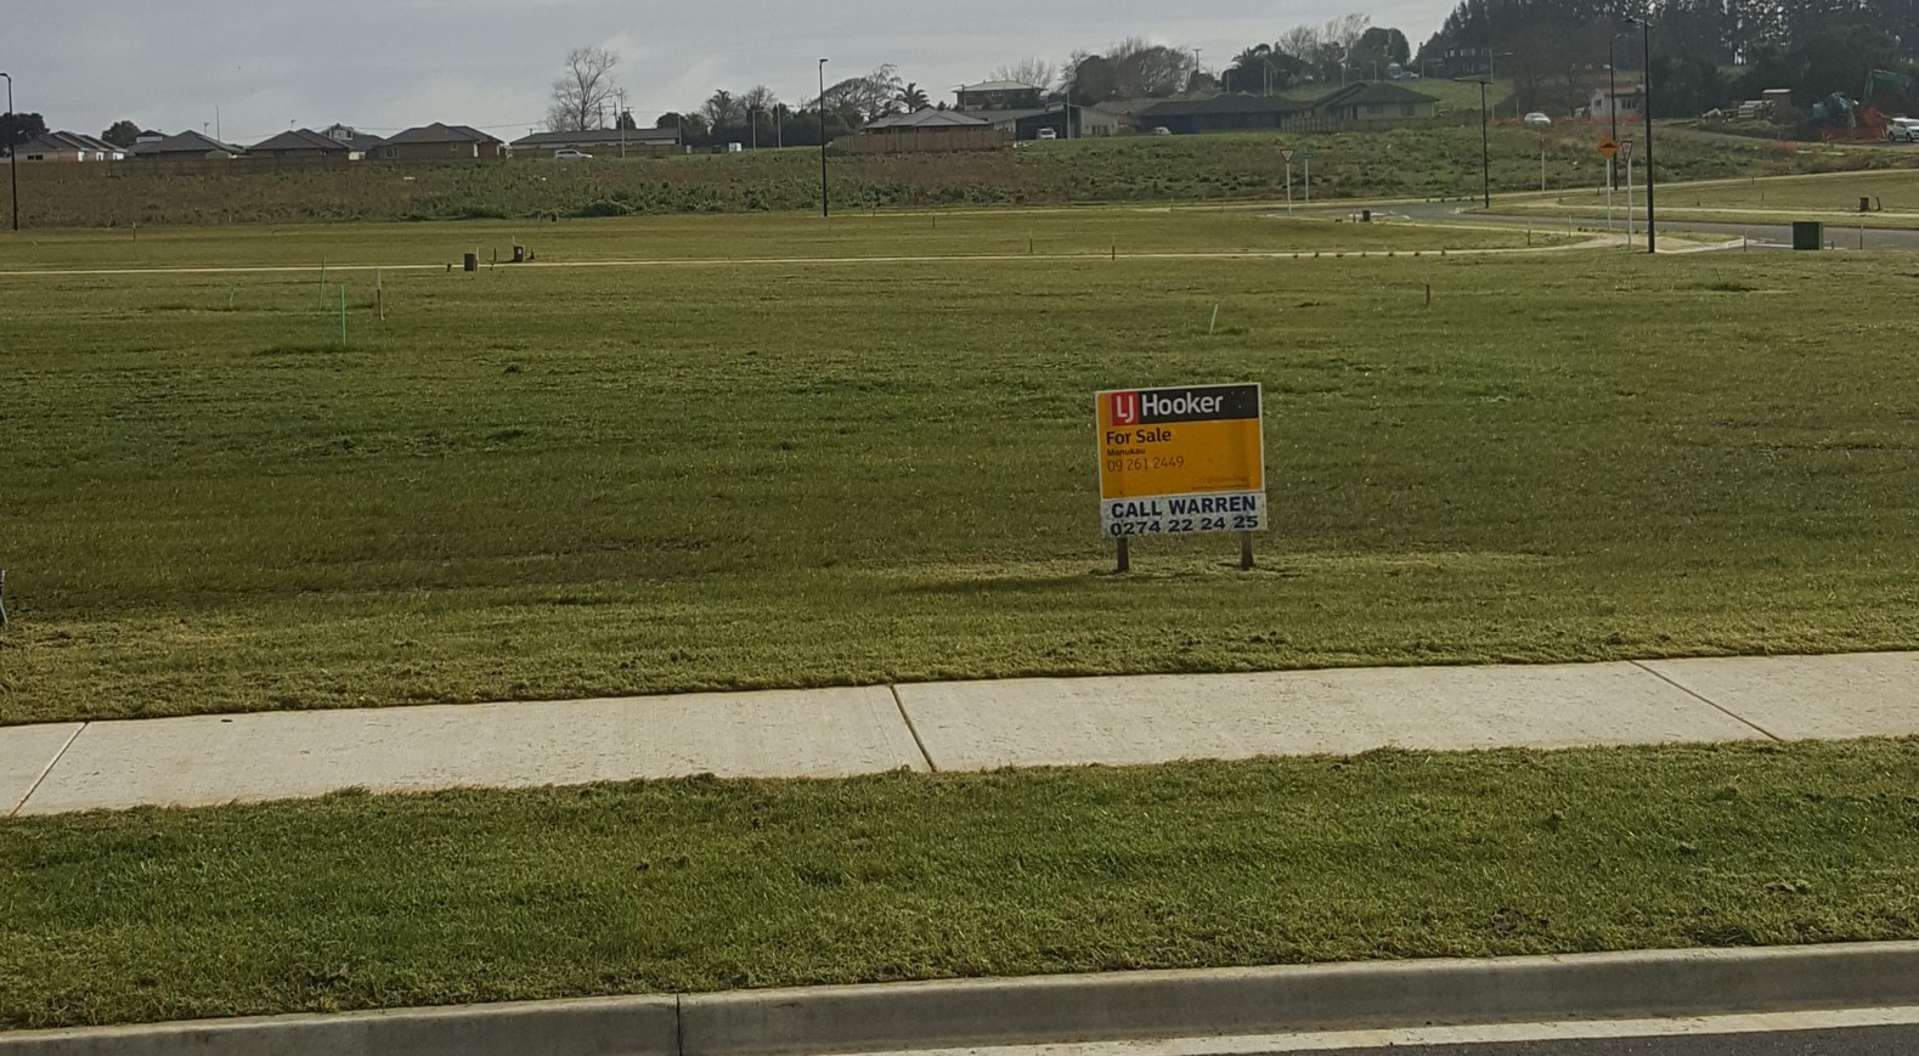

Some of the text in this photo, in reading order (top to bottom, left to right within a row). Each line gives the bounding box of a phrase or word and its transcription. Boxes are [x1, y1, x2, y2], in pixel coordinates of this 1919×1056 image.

[1115, 392, 1224, 423] LJ Hooker
[1106, 427, 1172, 445] For Sale
[1107, 455, 1185, 472] 09 261 2449
[1111, 495, 1256, 519] CALL WARREN
[1110, 515, 1259, 537] 0274 22 24 25
